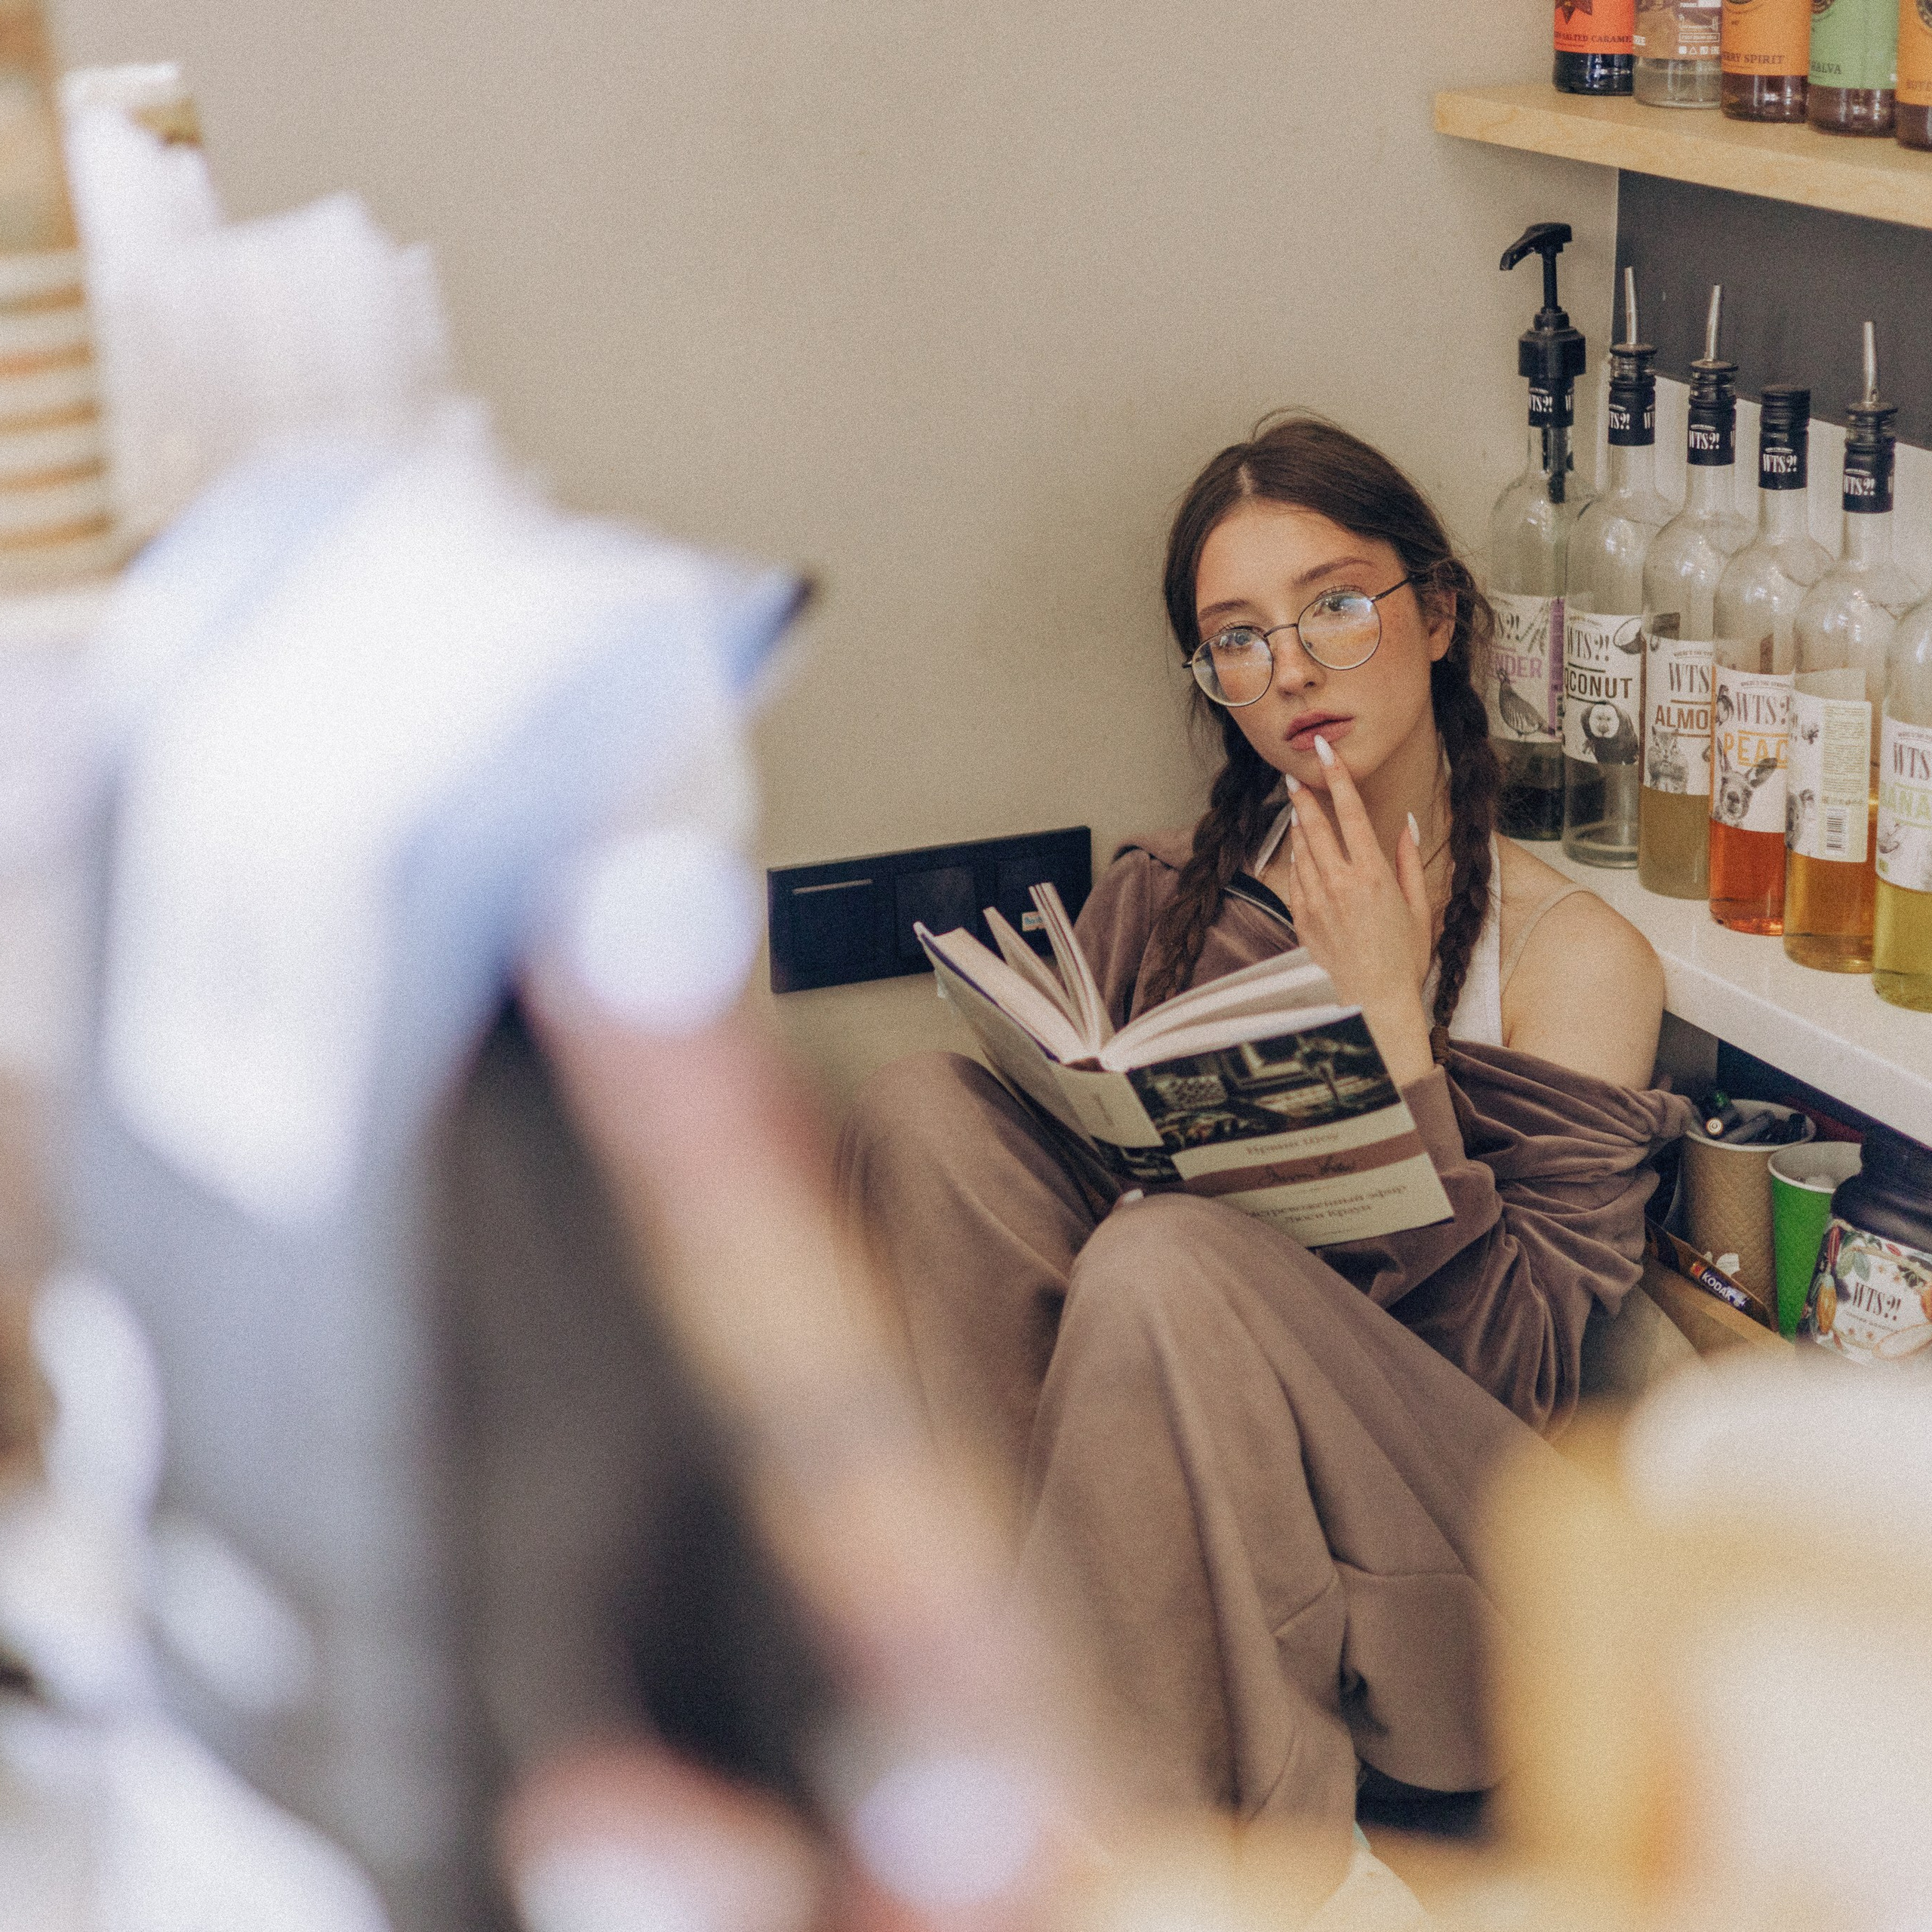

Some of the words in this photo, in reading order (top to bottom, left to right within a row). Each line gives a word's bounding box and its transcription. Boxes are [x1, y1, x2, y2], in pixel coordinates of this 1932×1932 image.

[1591, 35, 1632, 43] CARAME
[1744, 54, 1785, 64] SPIRIT
[1609, 411, 1630, 429] TS?!
[1688, 430, 1720, 450] WTS?!
[1762, 453, 1798, 473] WTS?!
[1567, 626, 1610, 662] WTS?!
[1564, 667, 1632, 699] OCONUT
[1669, 662, 1710, 694] WTS
[1655, 704, 1709, 731] ALMO
[1736, 691, 1791, 725] WTS?
[1723, 731, 1789, 764] PEAC
[1893, 742, 1932, 782] WTS
[1701, 1271, 1734, 1303] KODAK
[1851, 1281, 1902, 1321] WTS?!
